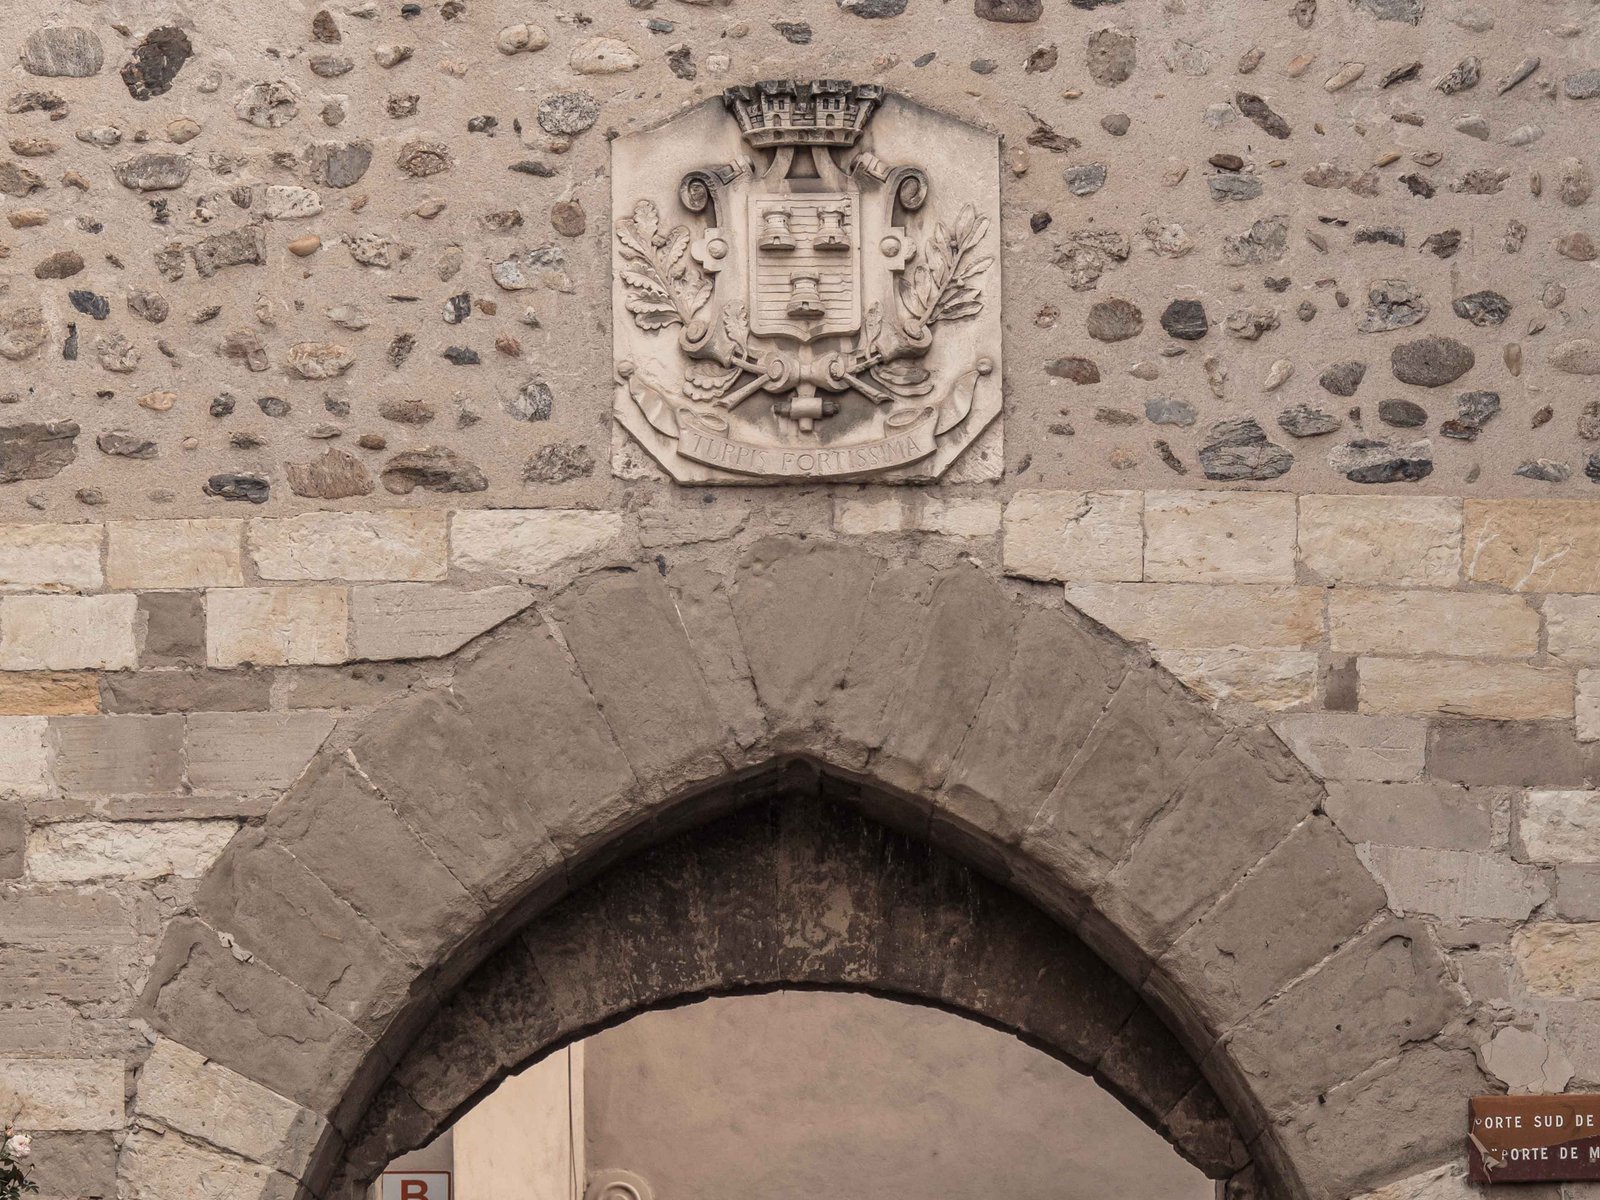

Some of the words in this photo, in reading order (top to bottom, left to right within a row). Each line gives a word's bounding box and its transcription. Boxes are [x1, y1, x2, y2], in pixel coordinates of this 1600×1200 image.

[782, 435, 922, 472] FORTISSIMA
[1534, 1115, 1564, 1128] SUD
[1575, 1114, 1594, 1127] DE
[1560, 1147, 1578, 1159] DE
